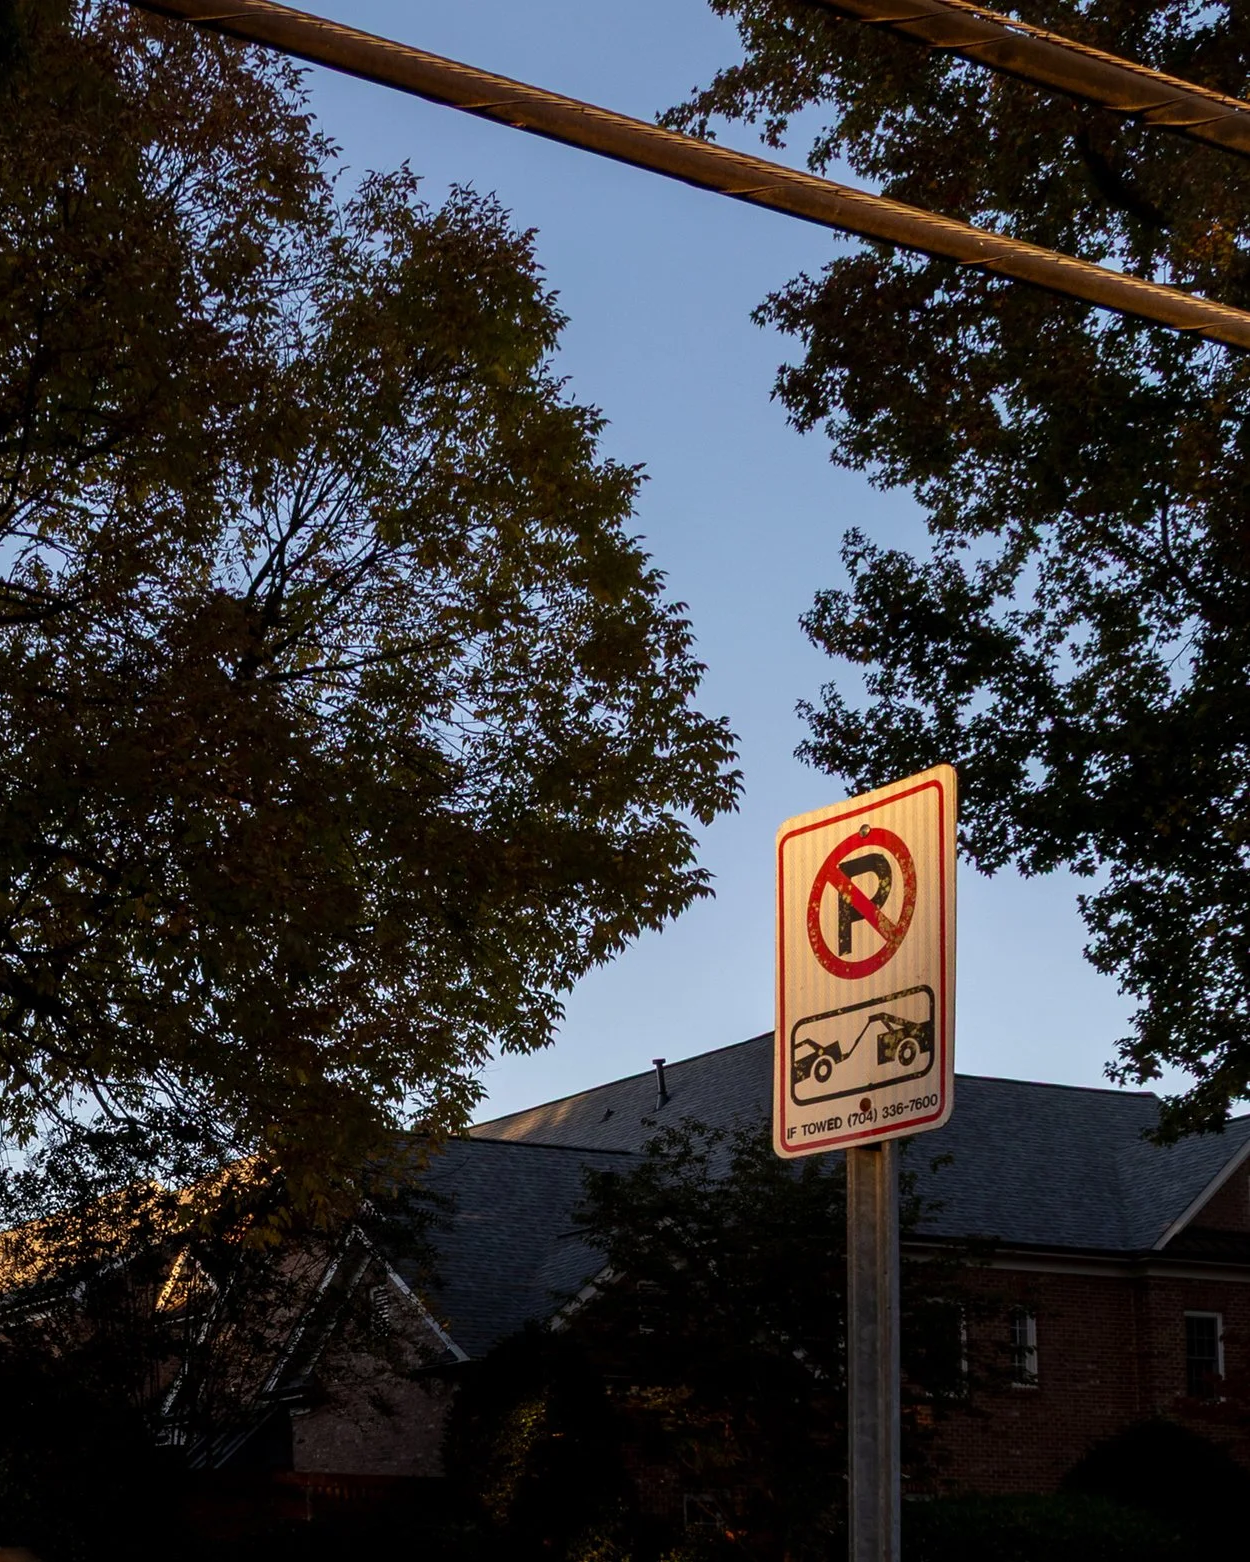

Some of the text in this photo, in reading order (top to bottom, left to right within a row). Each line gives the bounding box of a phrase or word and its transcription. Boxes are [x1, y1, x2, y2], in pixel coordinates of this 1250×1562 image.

[838, 853, 892, 956] P
[787, 1094, 938, 1140] IF TOWED (704) 336-7600
